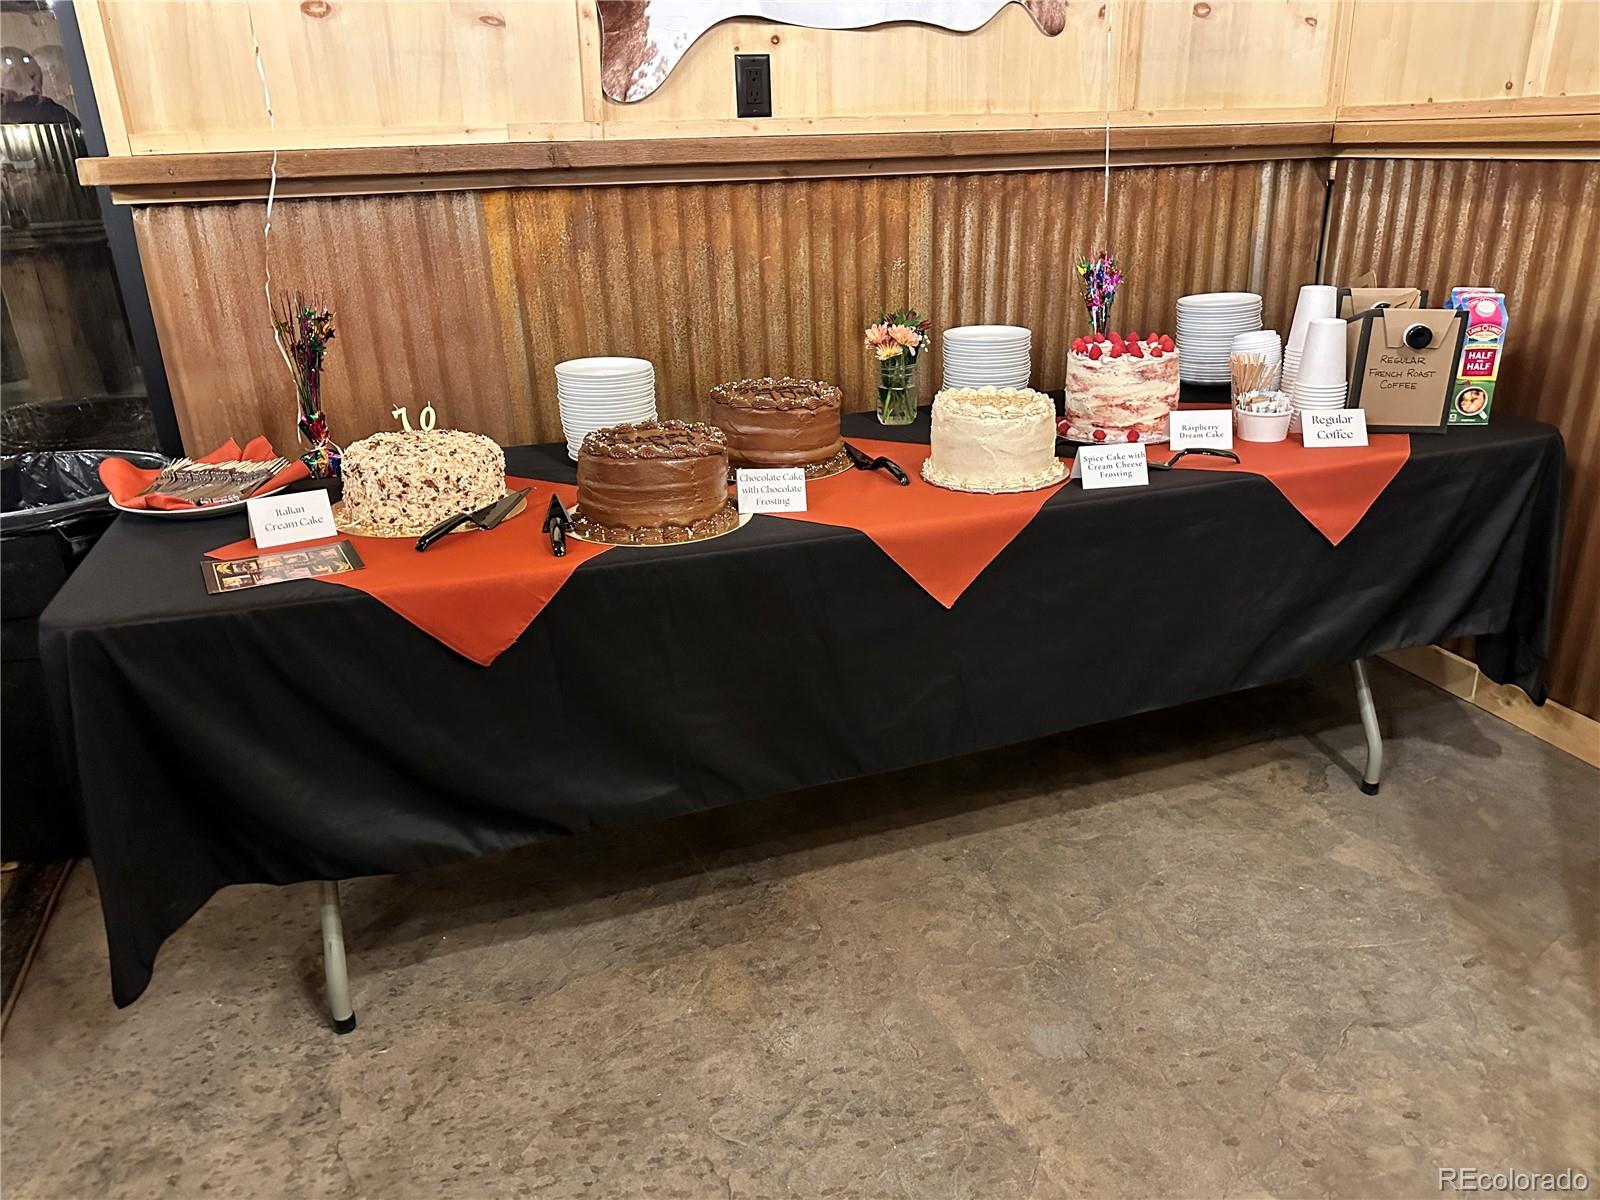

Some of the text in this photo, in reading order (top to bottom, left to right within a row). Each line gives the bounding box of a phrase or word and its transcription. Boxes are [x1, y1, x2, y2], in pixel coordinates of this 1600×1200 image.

[1381, 354, 1426, 365] REGULAR
[1468, 351, 1493, 360] HALF
[1466, 362, 1491, 370] HALF
[1368, 368, 1437, 378] FRENCH ROAST
[1379, 379, 1418, 390] COFFEE
[1311, 414, 1353, 427] Regular
[1181, 423, 1220, 432] Raspberry
[1205, 430, 1224, 438] Cake
[1316, 429, 1354, 440] Coffee
[1083, 450, 1146, 465] Spice Cake with
[1087, 461, 1143, 471] Cream Cheese
[739, 472, 804, 482] Chocolate Cake
[1099, 470, 1133, 479] Frosting
[741, 484, 803, 494] with Chocolate
[756, 498, 791, 507] Frosting
[275, 504, 306, 518] Italian
[264, 515, 325, 533] Cream Cake
